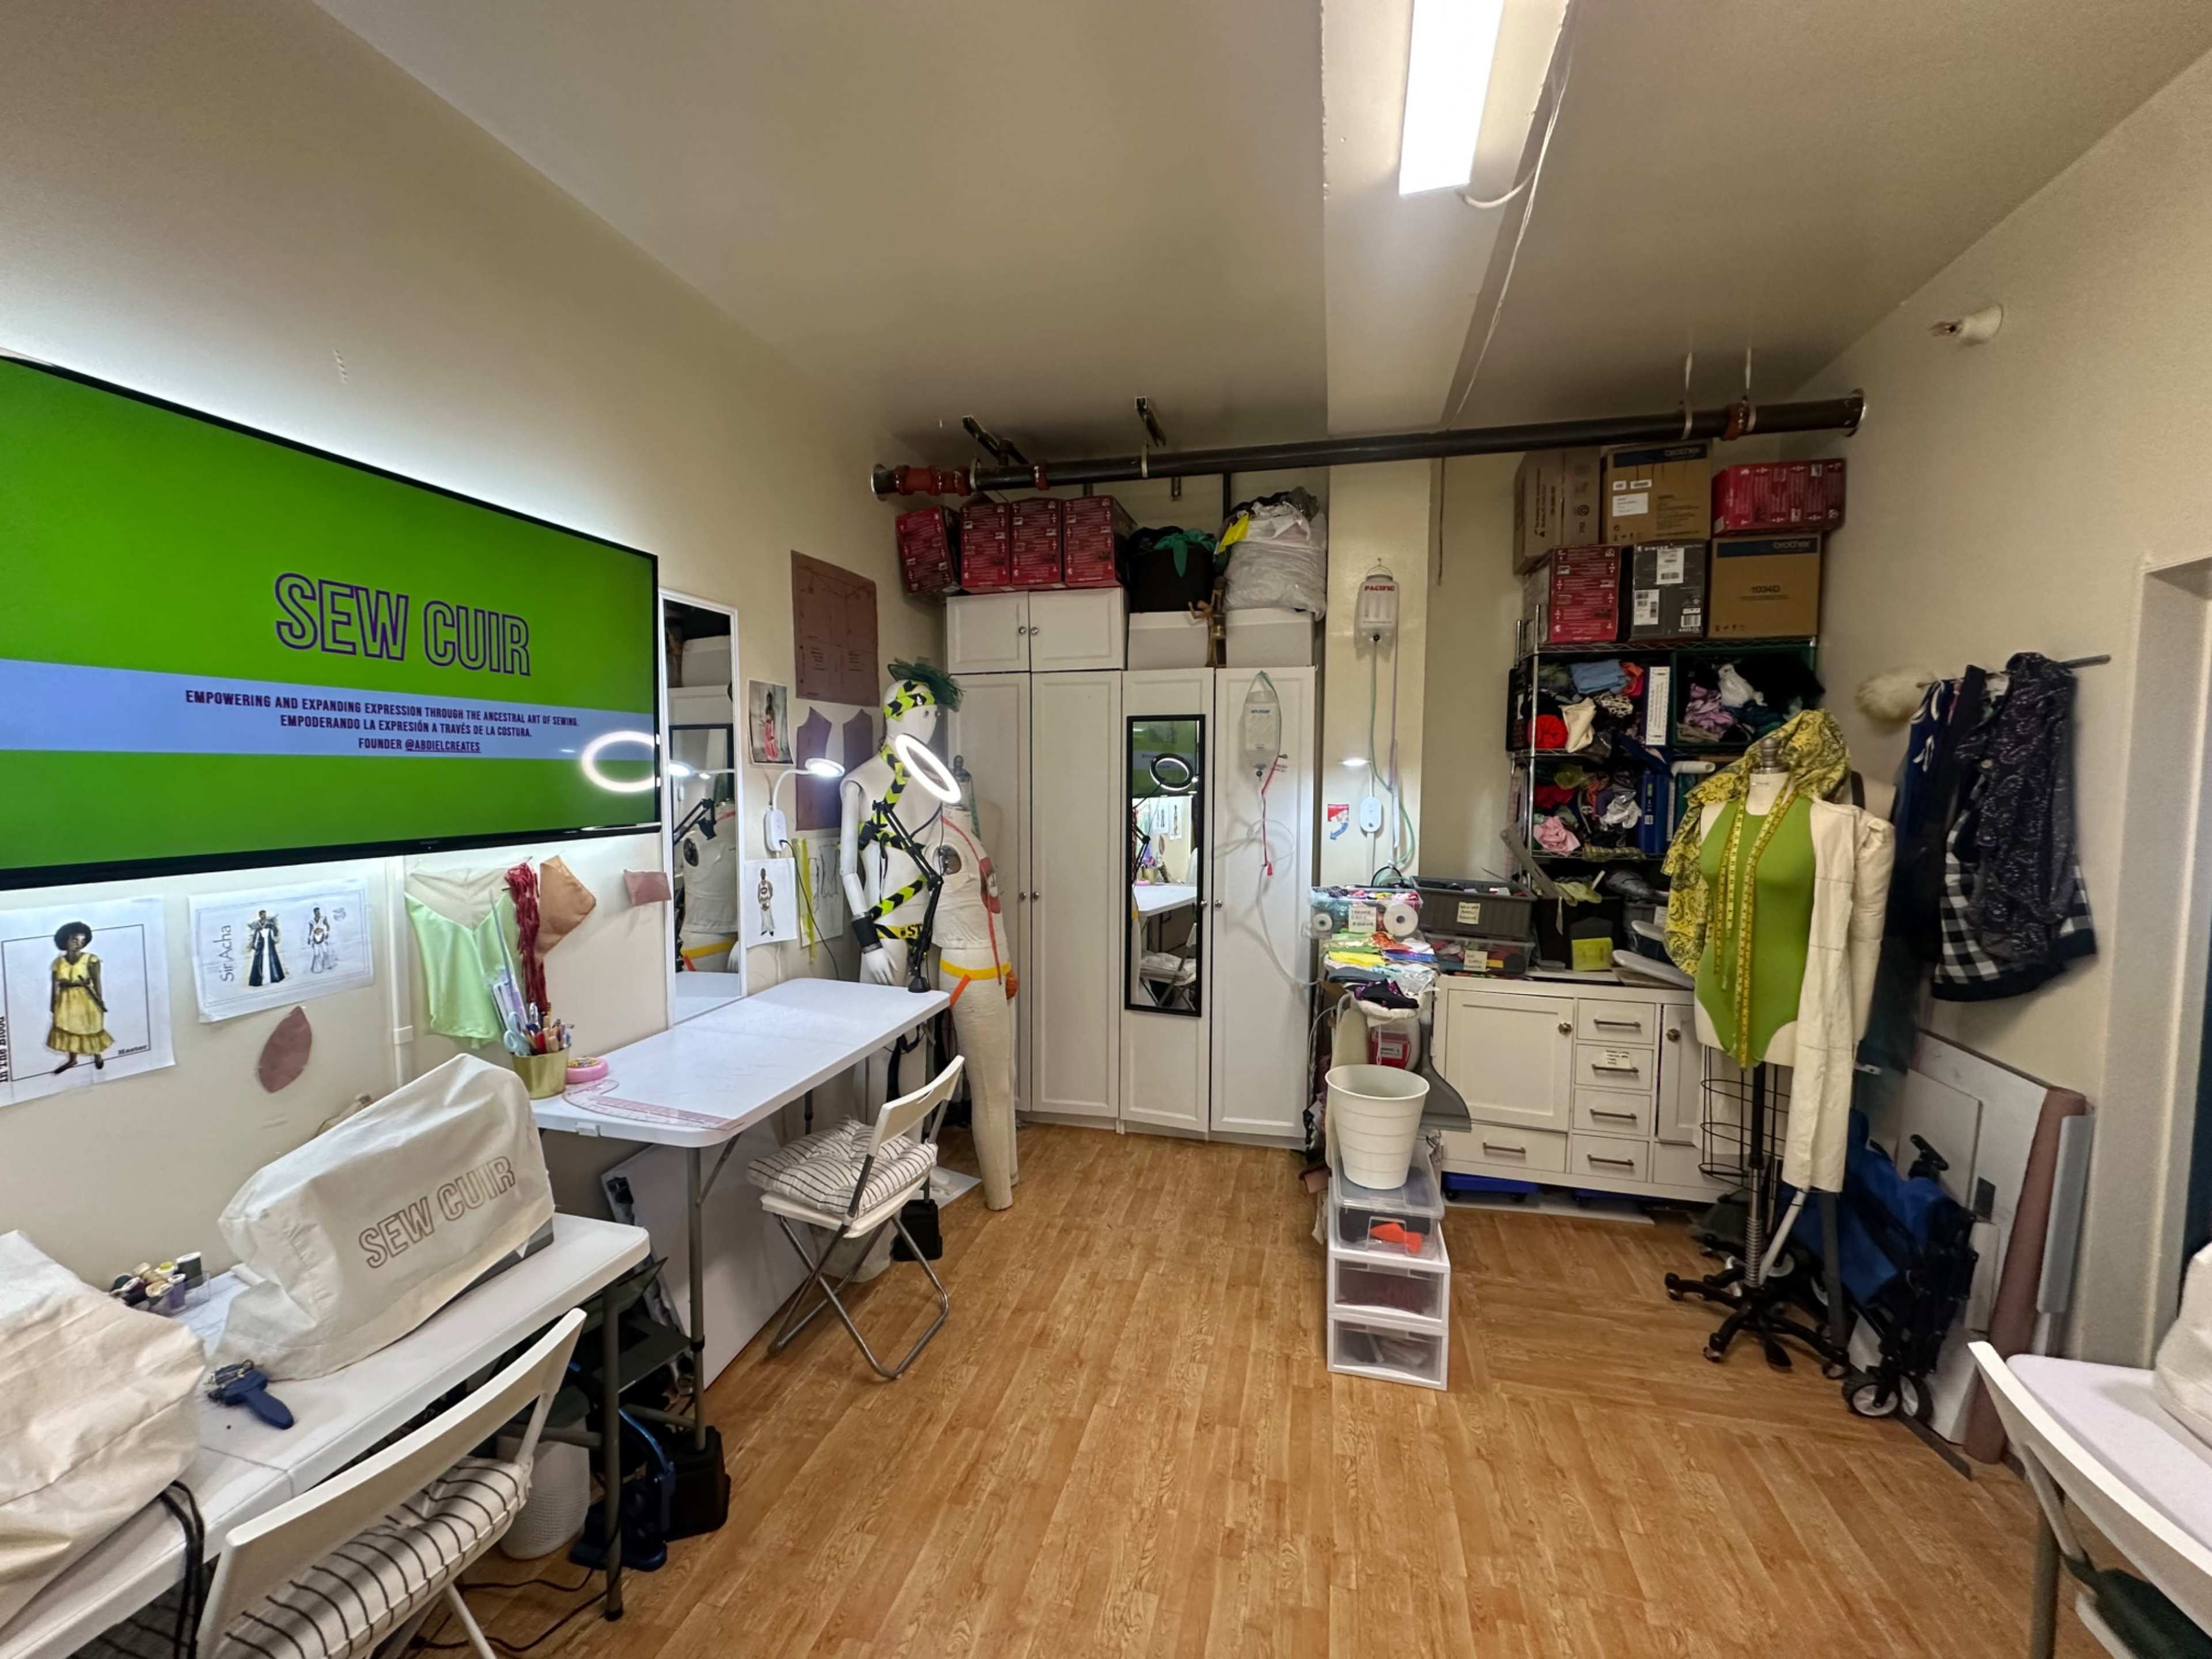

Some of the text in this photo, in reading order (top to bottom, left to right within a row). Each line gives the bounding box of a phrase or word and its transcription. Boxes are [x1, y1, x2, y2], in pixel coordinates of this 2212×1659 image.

[274, 572, 531, 677] SEW CUIR
[185, 690, 579, 726] EMPOWERING AND EXPANDING EXPRESSION THROUGH THE ANCESTRAL ART OF SEWING.
[281, 715, 532, 737] EMPODERANDO LA EXPRESIÓN A TRAVÉS DE LA COSTURA.
[358, 738, 480, 752] FOUNDER @ABDIELCREATES
[220, 963, 234, 982] Sir
[358, 1156, 517, 1269] SEW CUIR
